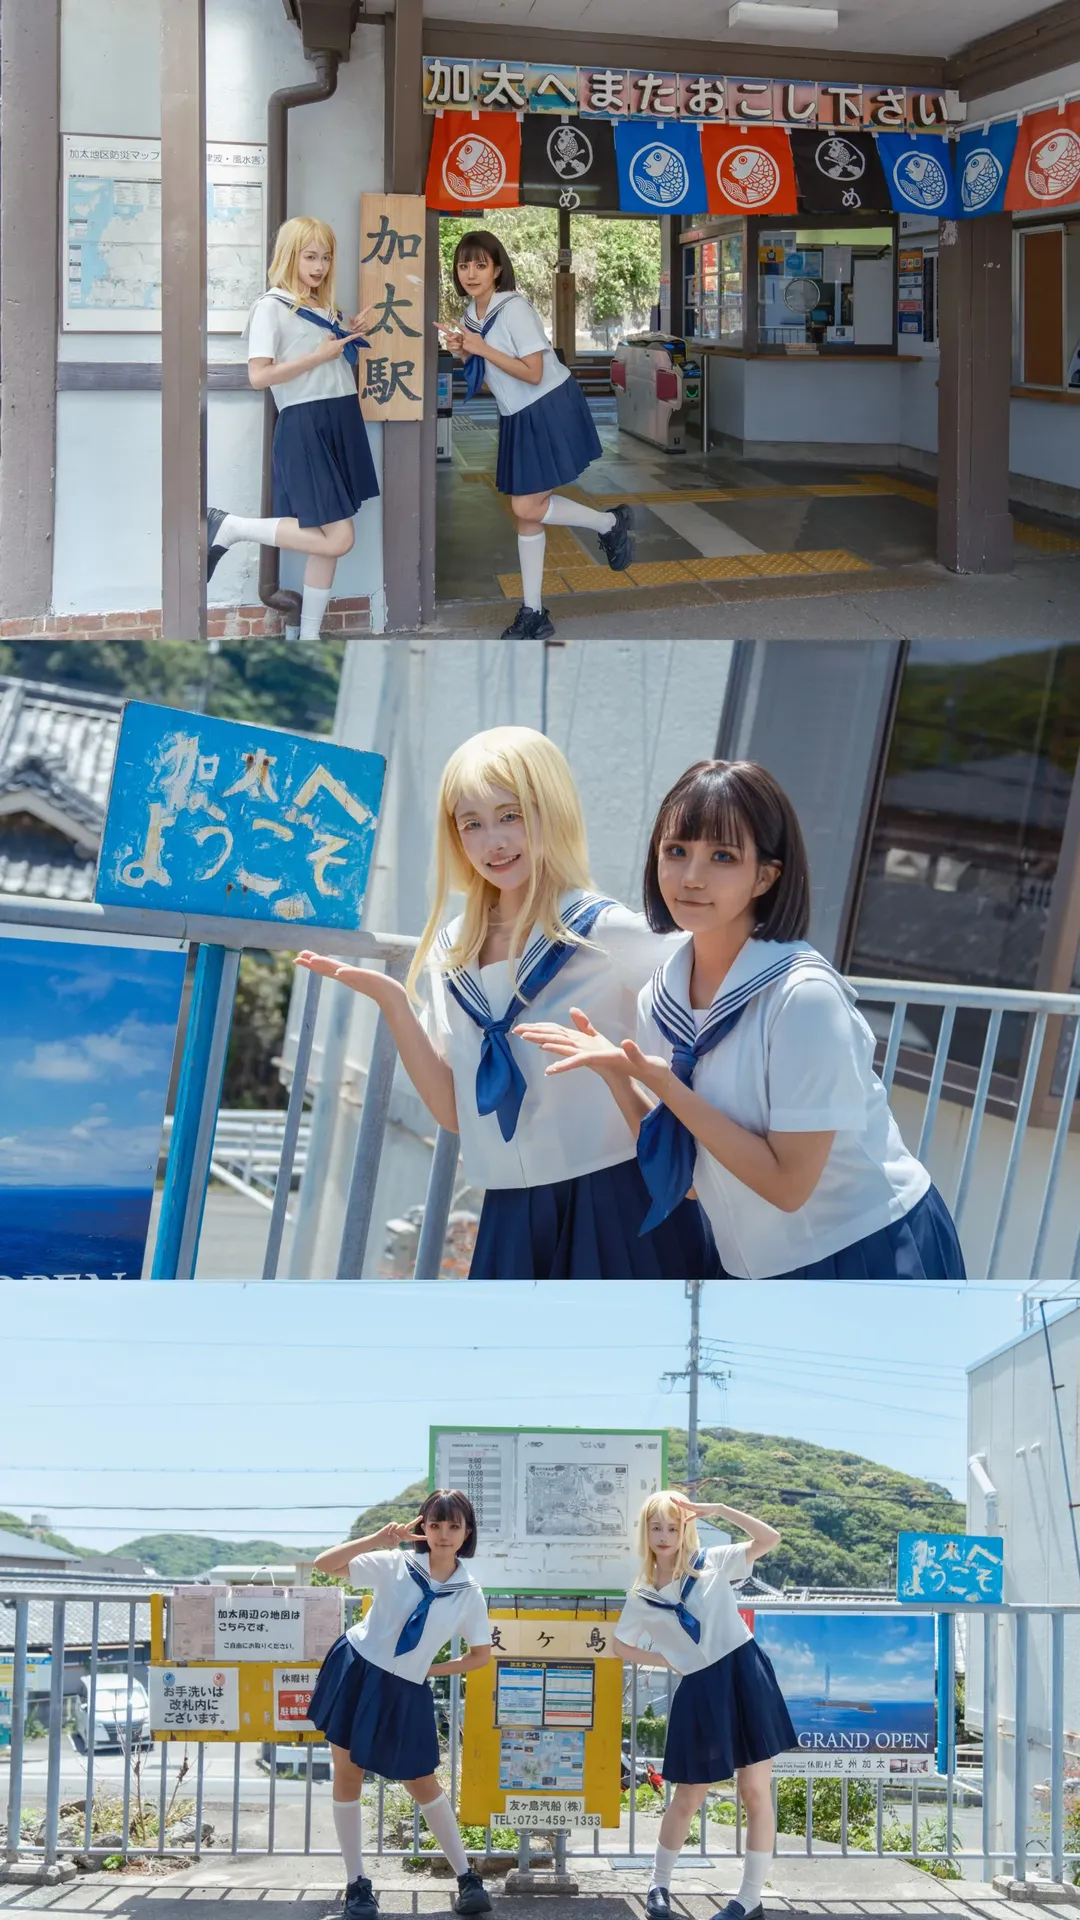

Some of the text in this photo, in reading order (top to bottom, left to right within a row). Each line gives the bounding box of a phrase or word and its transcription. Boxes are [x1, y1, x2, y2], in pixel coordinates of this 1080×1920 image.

[428, 59, 948, 127] 加太へまたおこし下さい
[558, 187, 581, 211] め
[841, 188, 862, 209] め
[361, 215, 423, 405] 加太駅
[155, 732, 373, 826] 加太へ
[117, 803, 350, 900] ようこそ
[217, 1609, 301, 1620] 加太周辺の地図は
[218, 1622, 269, 1633] こちらです。
[223, 1642, 295, 1651] ご自由にお取りください。
[281, 1674, 310, 1684] 休暇村
[163, 1686, 224, 1698] お手洗いは
[169, 1699, 218, 1711] 改札内に
[163, 1712, 226, 1725] ございます。
[797, 1732, 930, 1749] GRAND OPEN
[834, 1758, 886, 1769] 紀州加太
[493, 1814, 601, 1826] TEL:073-459-1333
